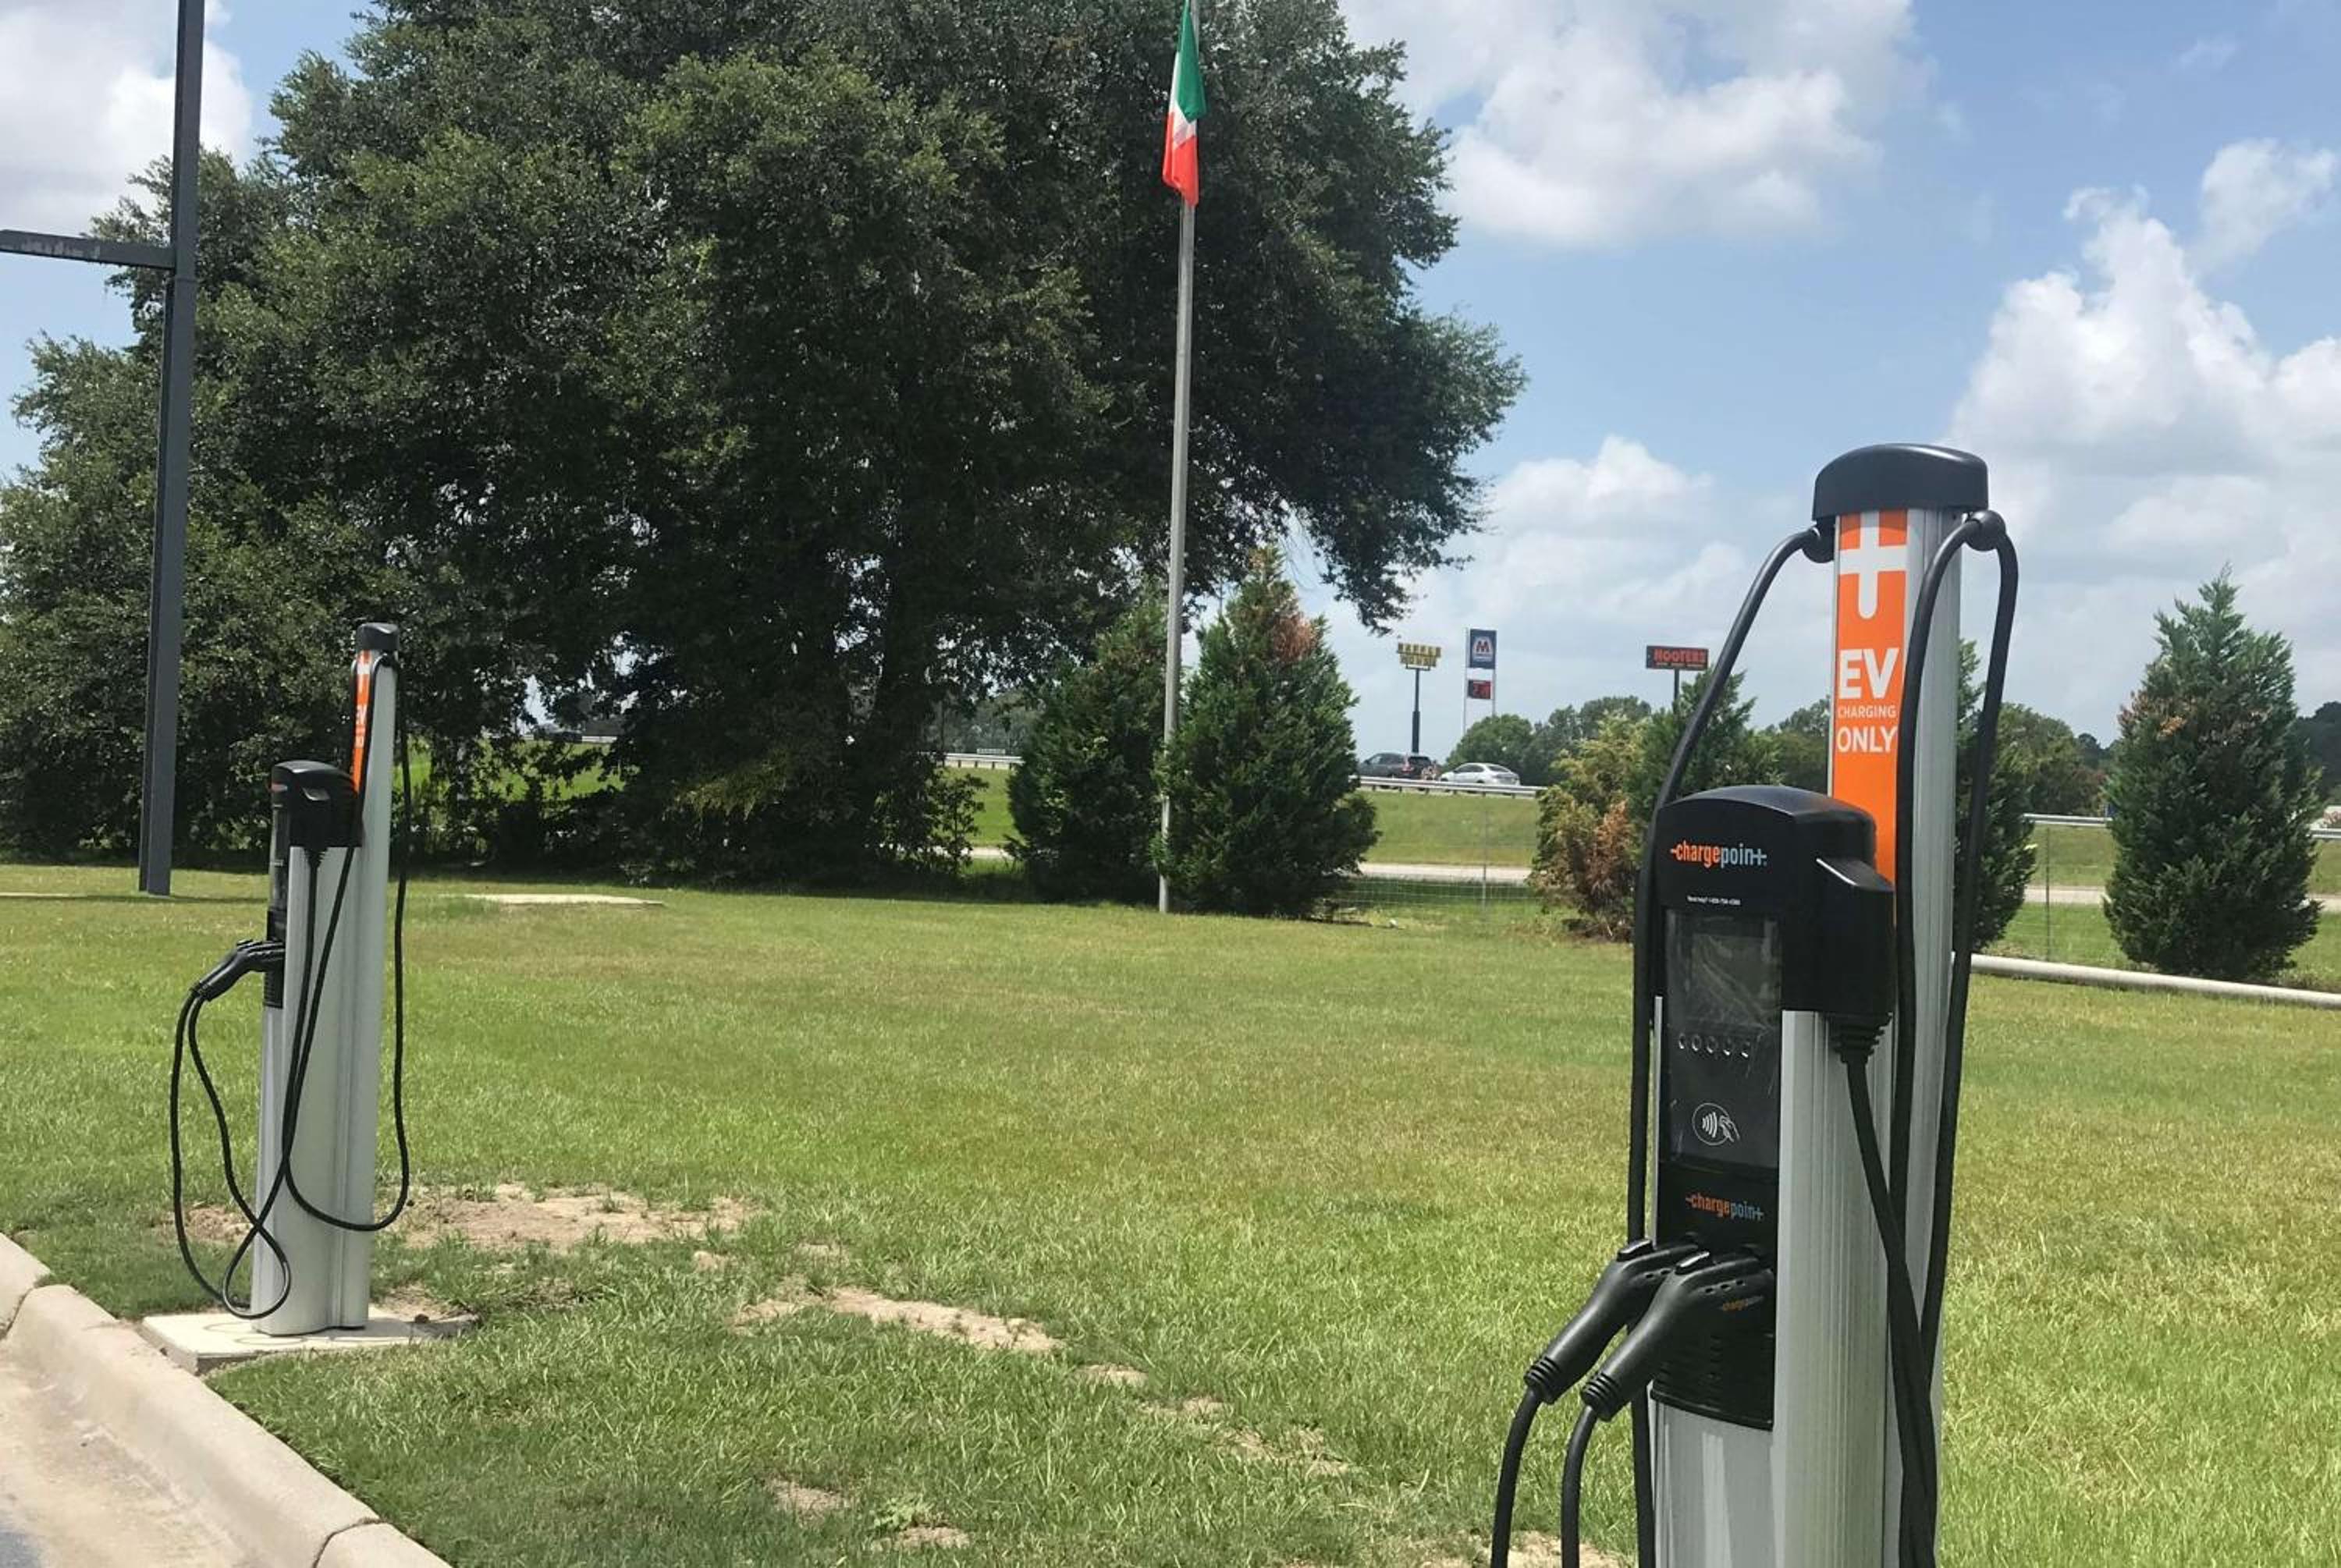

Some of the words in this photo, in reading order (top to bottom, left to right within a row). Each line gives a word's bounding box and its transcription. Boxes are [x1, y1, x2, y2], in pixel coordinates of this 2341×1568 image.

[1838, 647, 1899, 699] EV
[1838, 704, 1897, 718] CHARGING
[1836, 725, 1899, 753] ONLY
